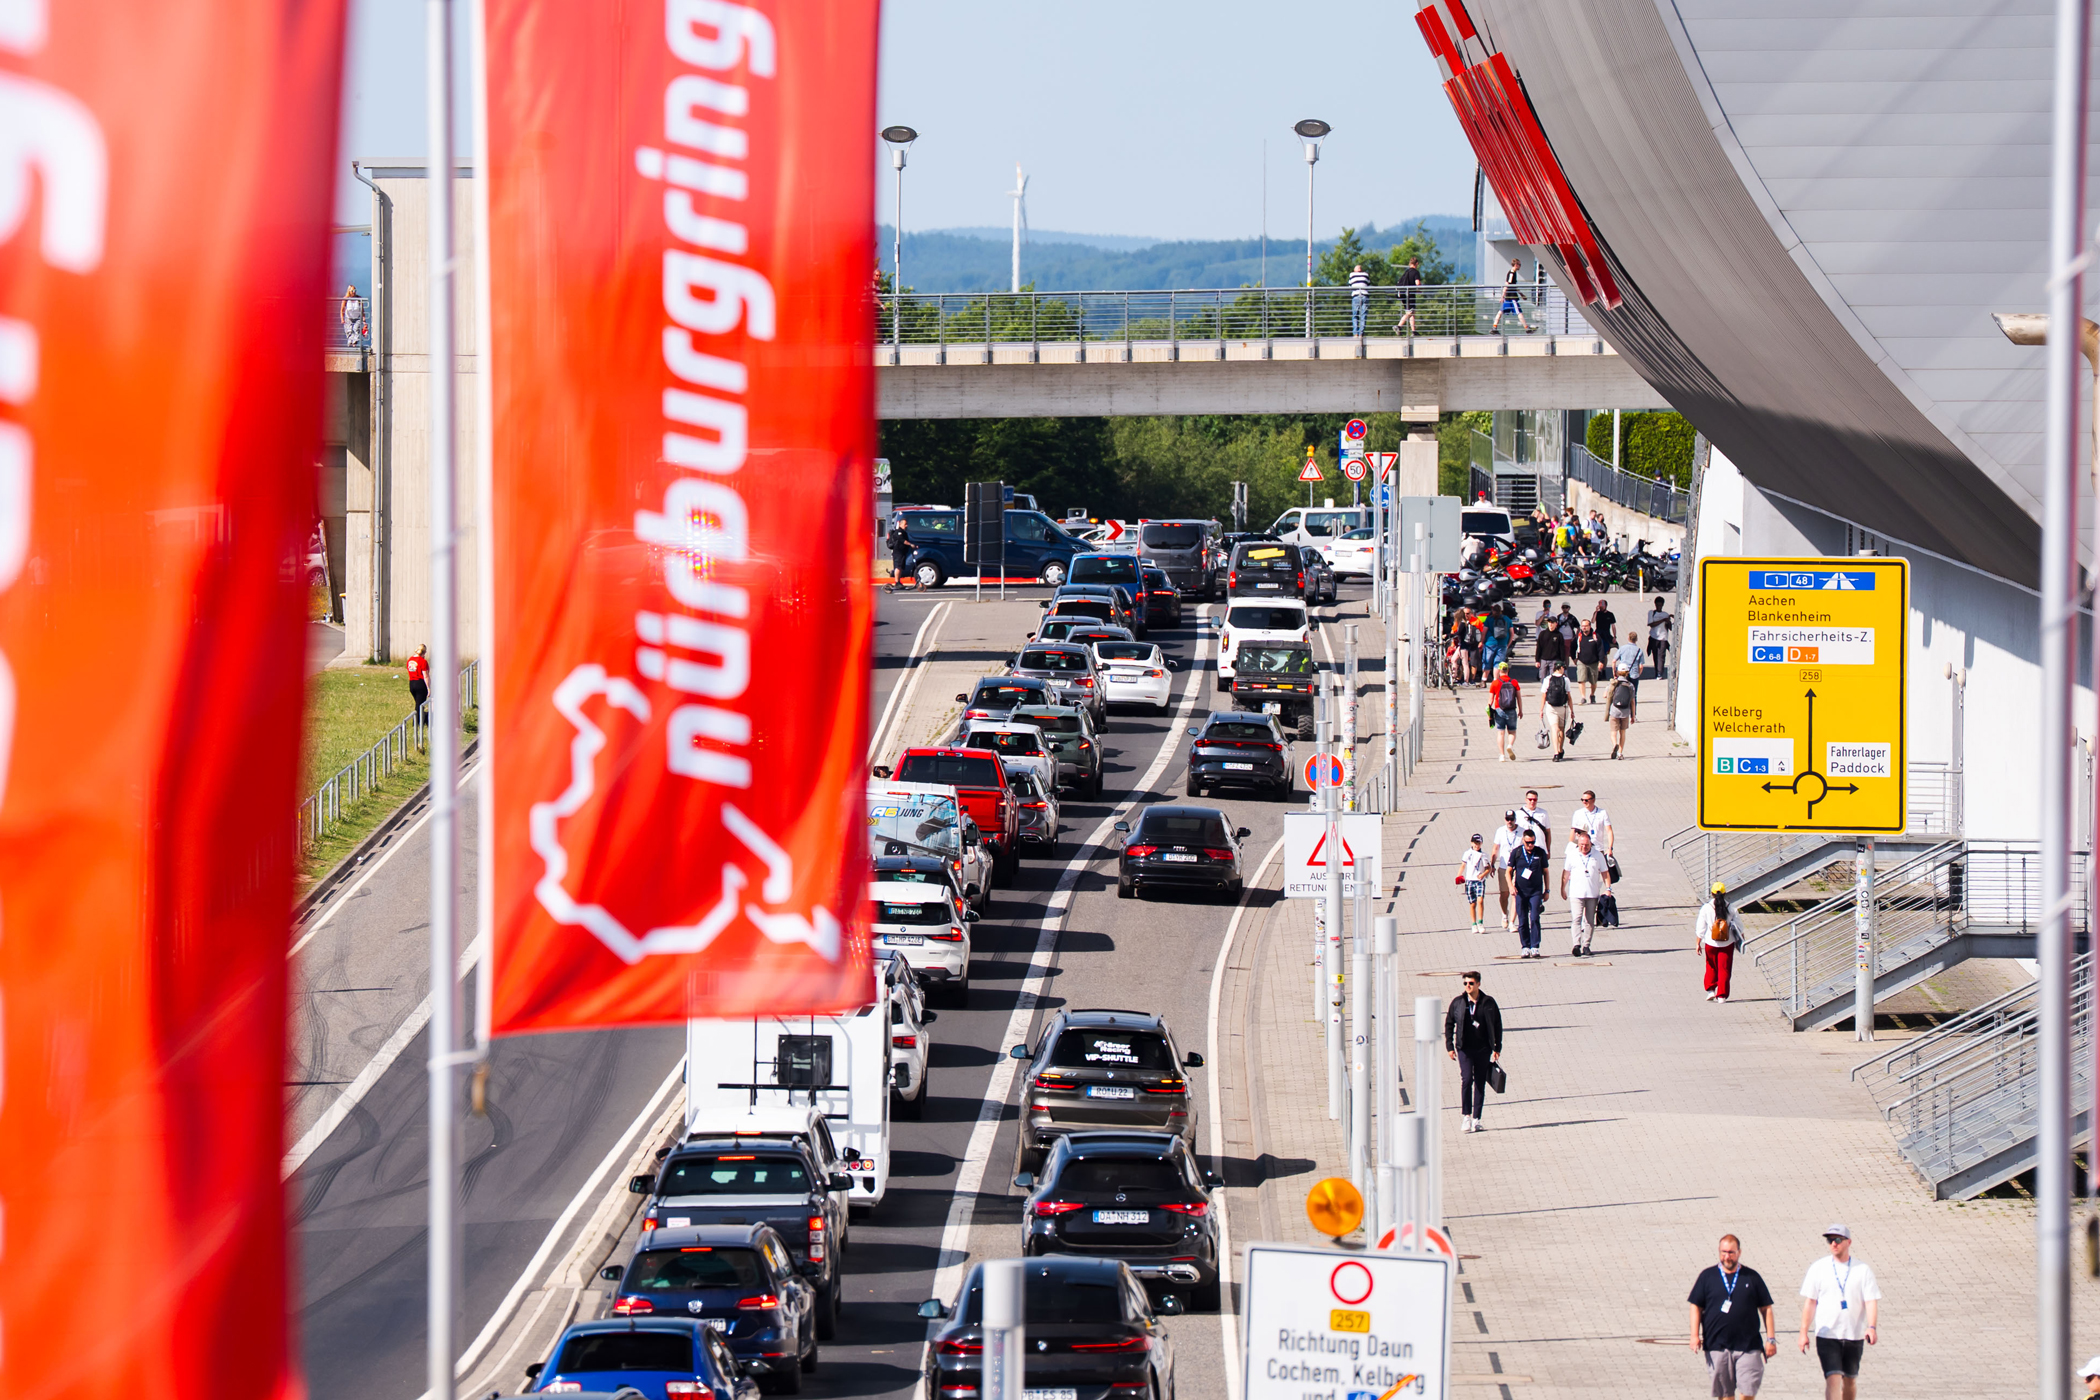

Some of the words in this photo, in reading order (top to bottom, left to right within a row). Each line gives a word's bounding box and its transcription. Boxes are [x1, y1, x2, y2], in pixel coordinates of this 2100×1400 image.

[635, 0, 777, 789] nürburgring
[1350, 465, 1362, 475] 50
[1795, 576, 1808, 585] 48
[1749, 595, 1796, 606] Aachen
[1748, 611, 1831, 622] Blankenheim
[1752, 630, 1872, 643] Fahrsicherheits-Z.
[1755, 648, 1766, 661] C
[1769, 653, 1781, 661] 6-8
[1790, 648, 1801, 661] D
[1802, 672, 1819, 680] 258
[1713, 706, 1763, 720] Kelberg
[1713, 722, 1786, 733] Welcherath
[1830, 746, 1886, 760] Fahrerlager
[1720, 759, 1731, 771] B
[1740, 759, 1752, 772] C
[1830, 762, 1885, 773] Paddock
[899, 808, 924, 818] JUNG
[1085, 1054, 1138, 1063] VIP-SHUTTLE
[1119, 1089, 1128, 1097] 22
[1131, 1212, 1147, 1221] 312
[1336, 1313, 1364, 1329] 257
[1279, 1329, 1360, 1361] Richtung
[1368, 1335, 1413, 1359] Daun
[1353, 1364, 1426, 1395] Kelbeg
